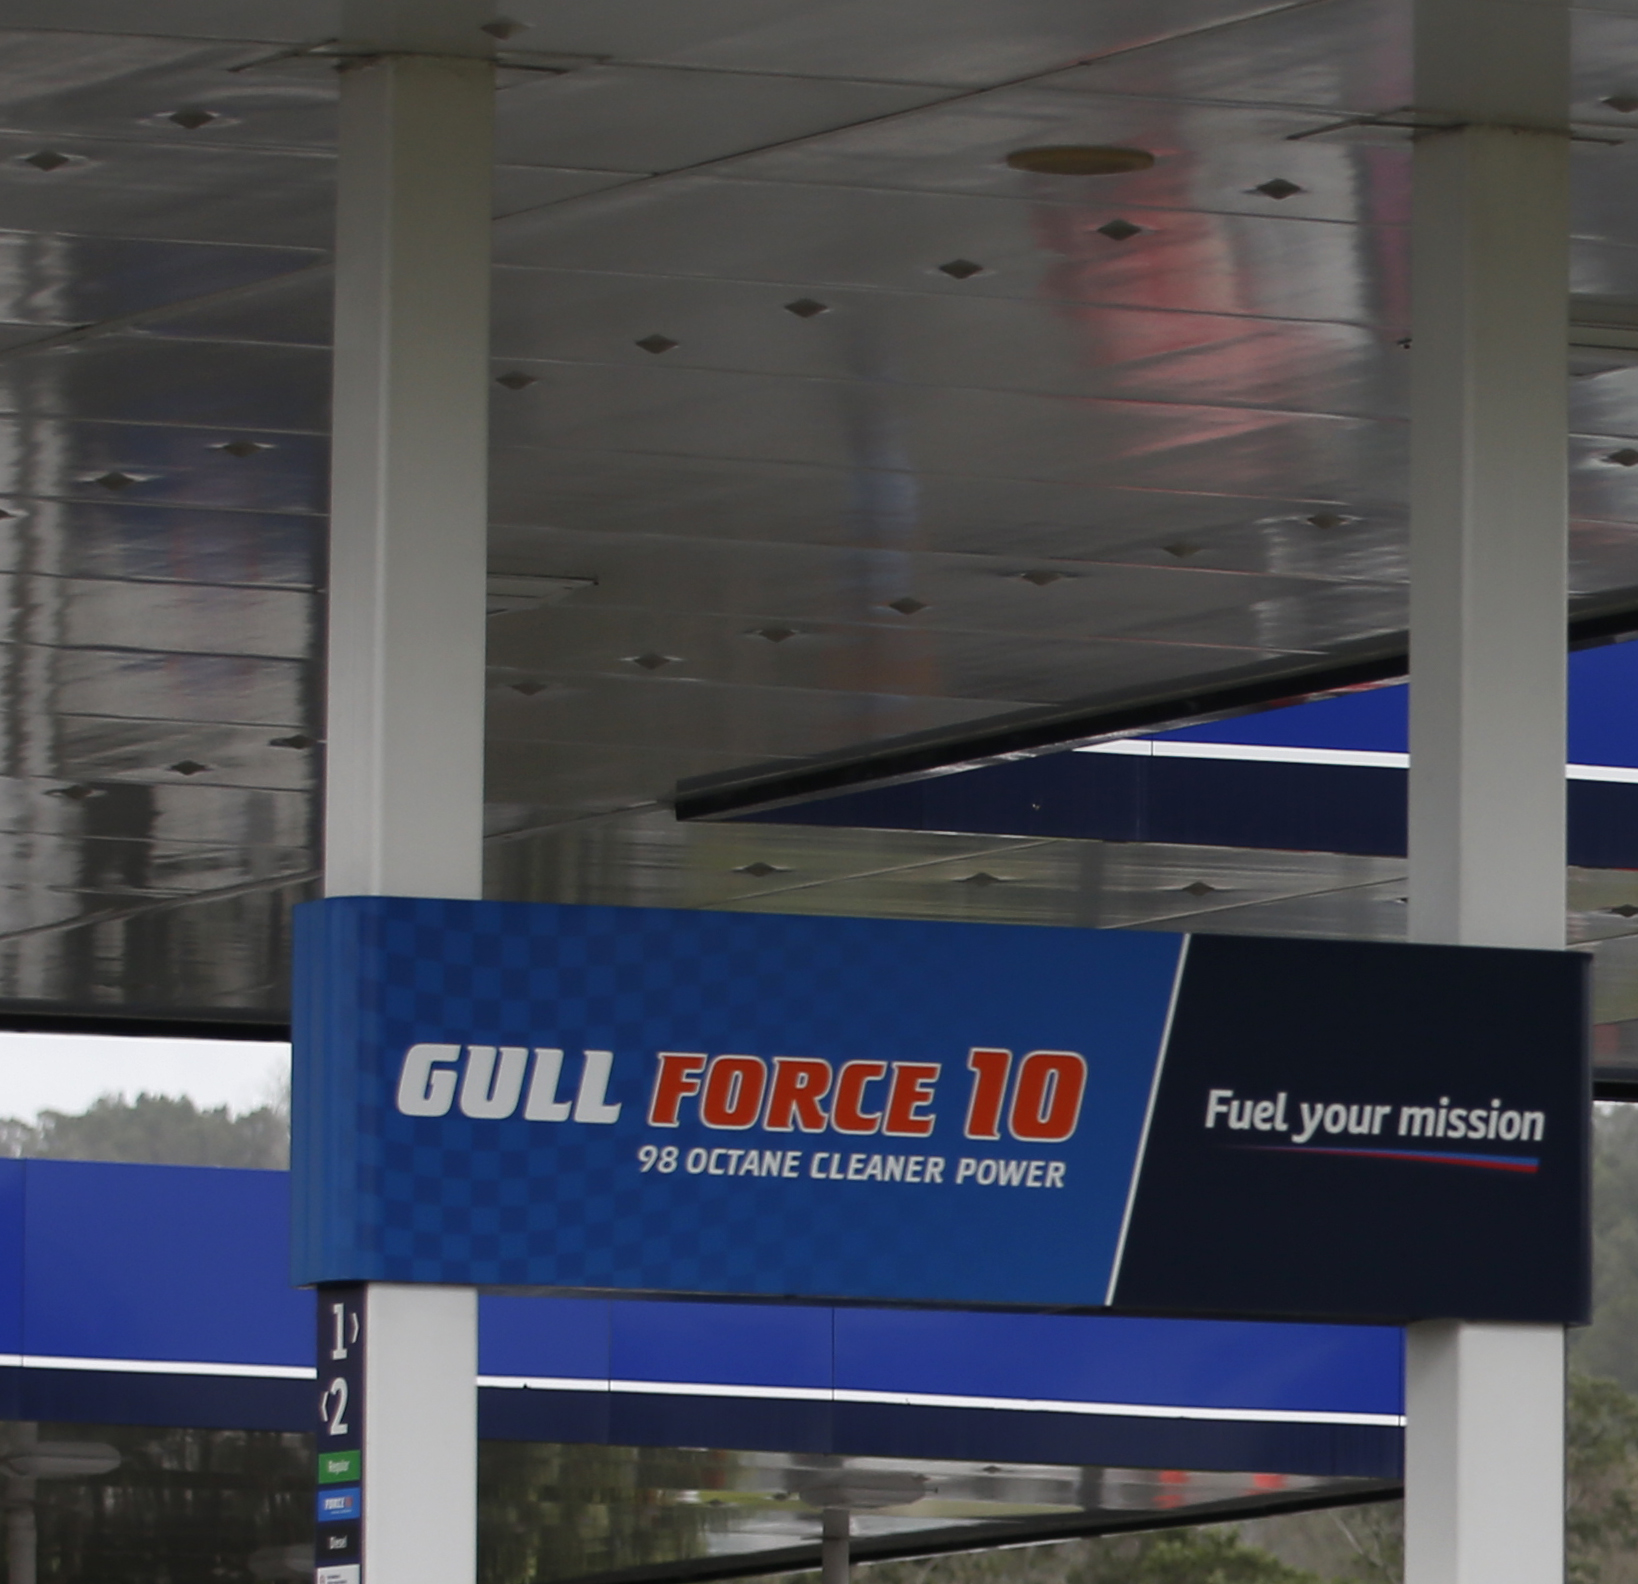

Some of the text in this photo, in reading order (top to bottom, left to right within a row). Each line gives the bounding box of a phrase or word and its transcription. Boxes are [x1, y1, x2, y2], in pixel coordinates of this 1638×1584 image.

[397, 1042, 1088, 1142] GULL FORCE 10
[1204, 1089, 1546, 1143] Fuel your mission
[637, 1144, 1066, 1189] 98 OCTANE CLEANER POWER
[329, 1377, 348, 1436] 2
